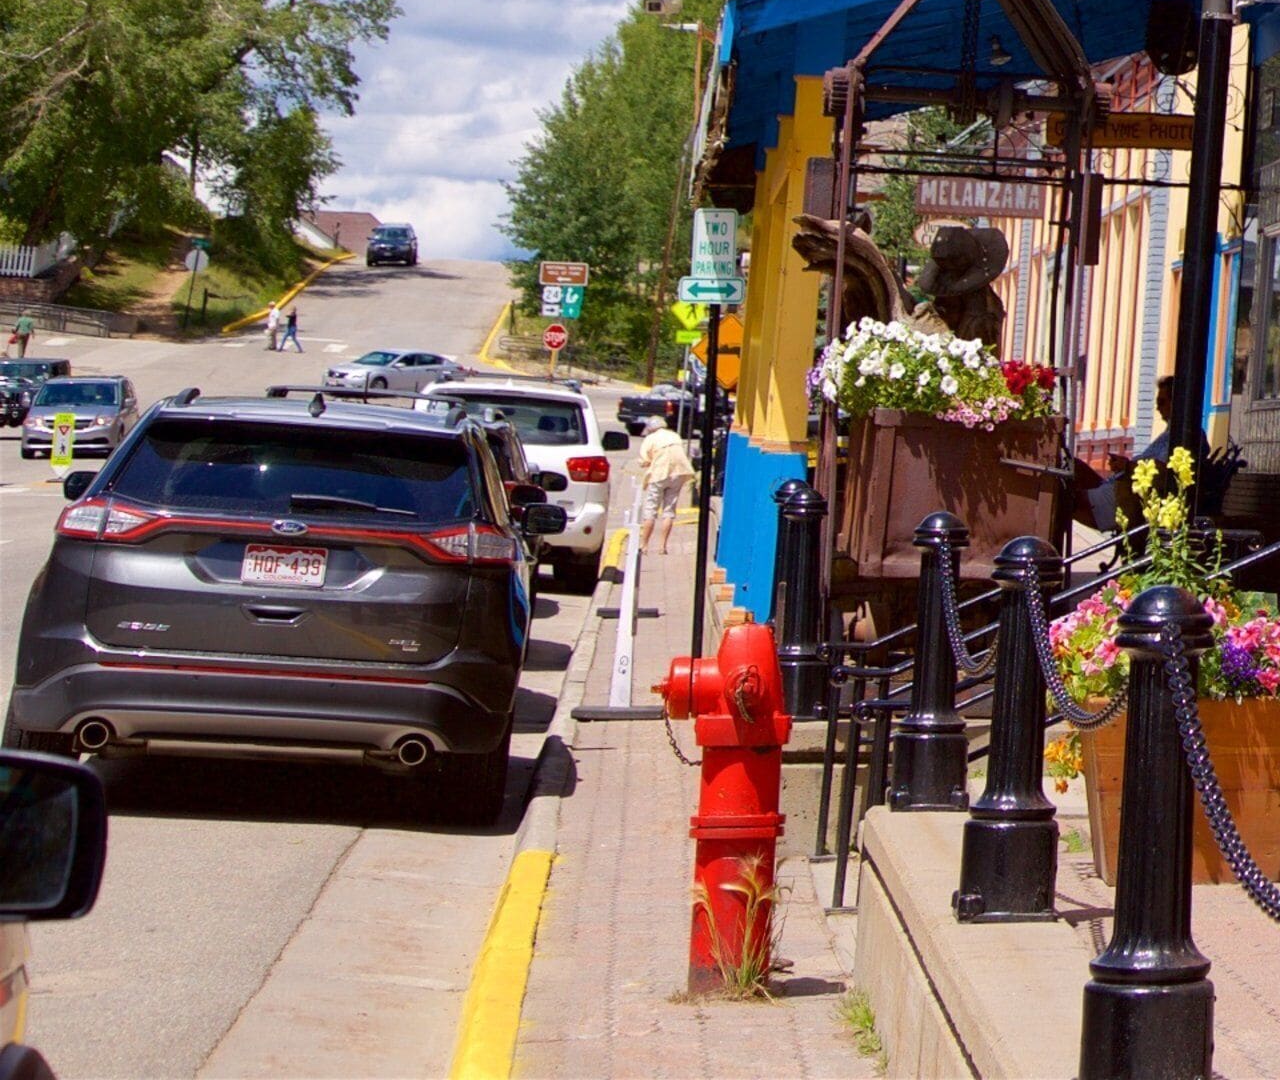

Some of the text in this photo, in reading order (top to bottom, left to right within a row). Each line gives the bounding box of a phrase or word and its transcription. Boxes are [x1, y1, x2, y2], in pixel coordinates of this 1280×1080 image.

[920, 178, 1040, 210] MELANZANA
[705, 221, 728, 236] TWO
[699, 241, 730, 256] HOUR
[695, 261, 733, 275] PARKING
[545, 288, 559, 300] 24
[544, 330, 567, 343] STOP
